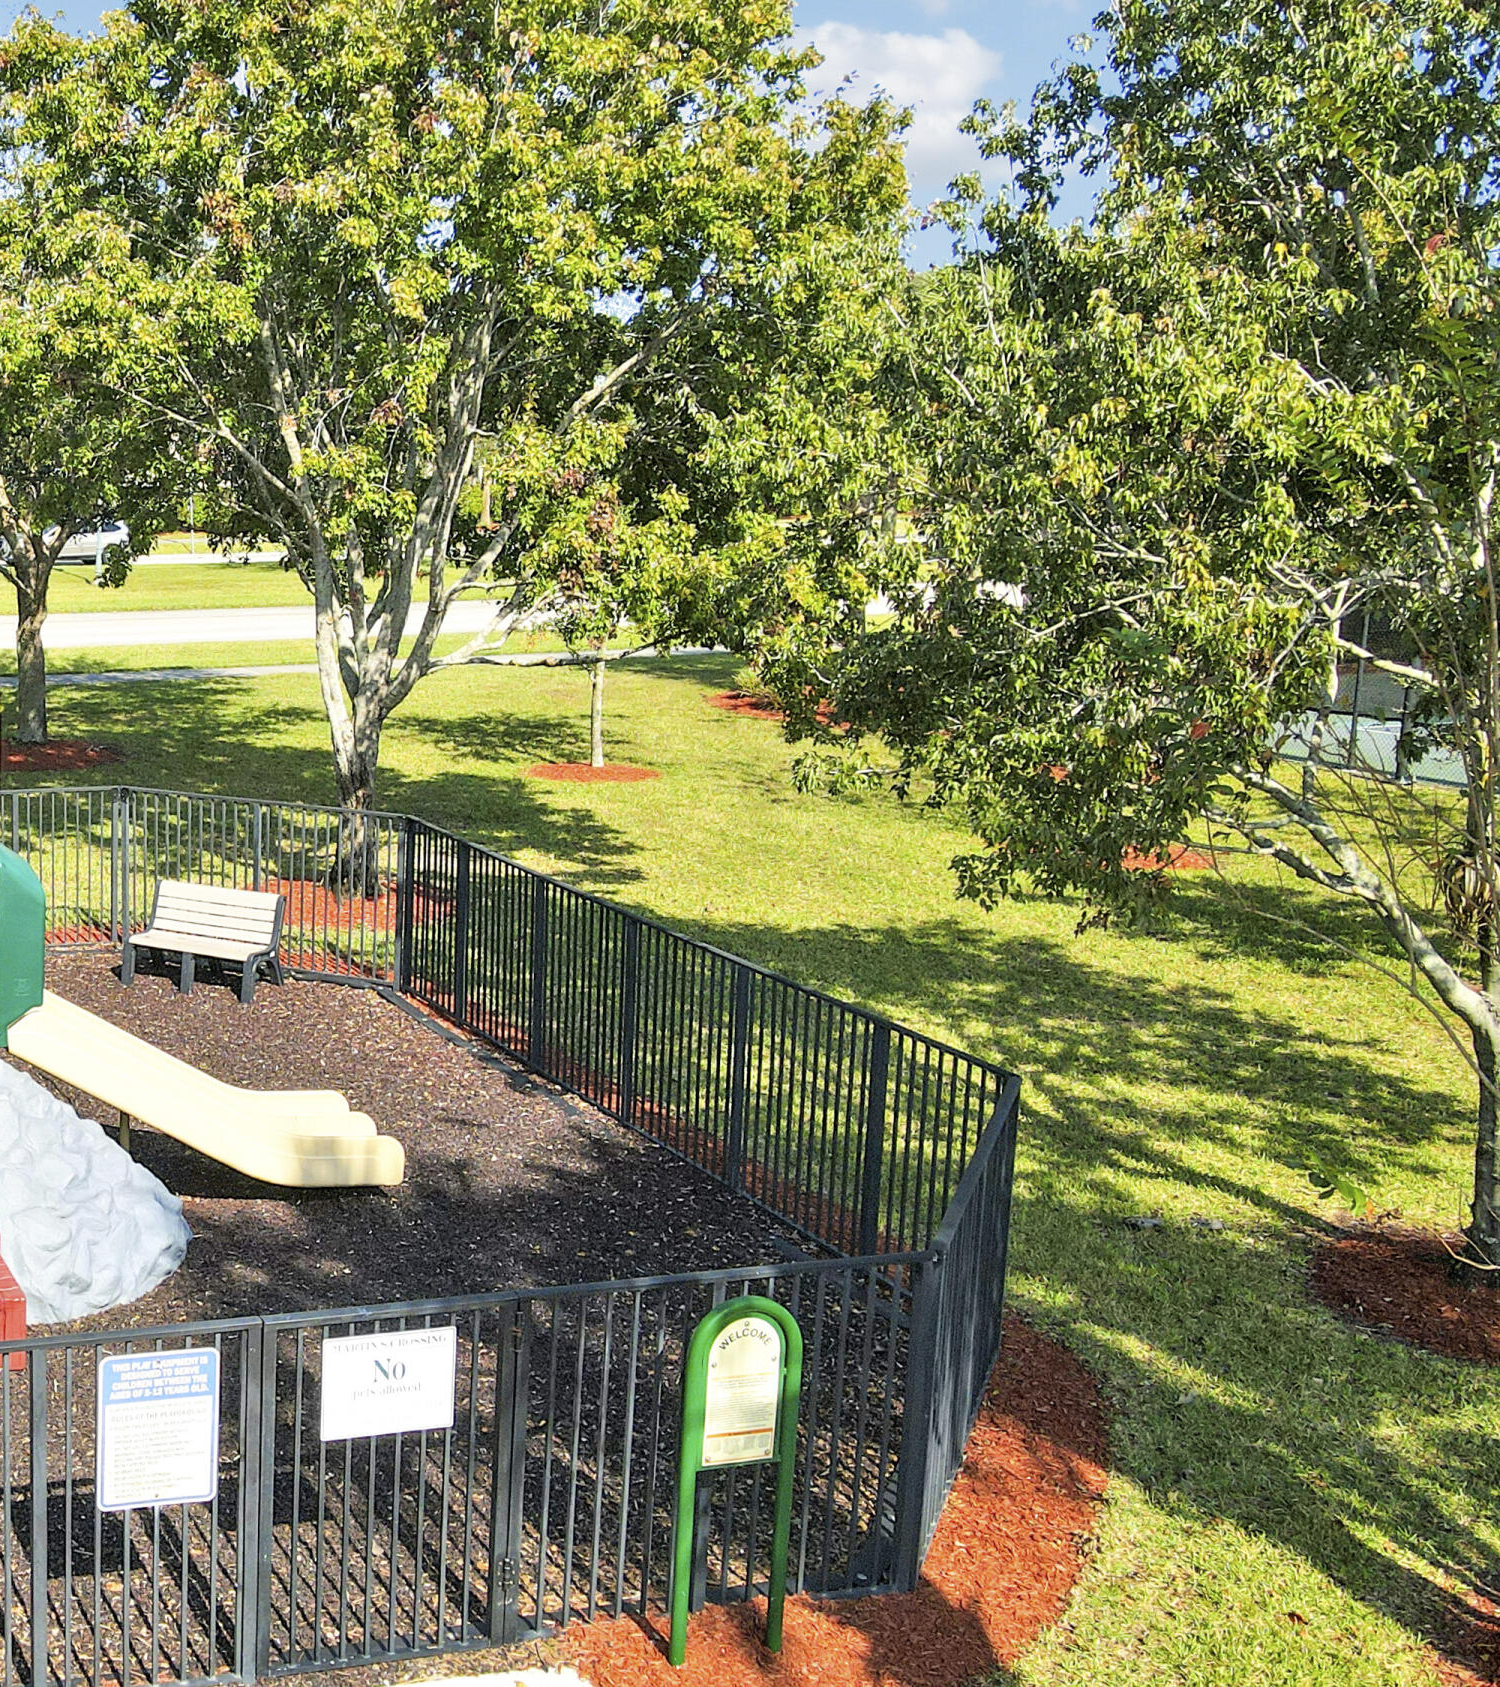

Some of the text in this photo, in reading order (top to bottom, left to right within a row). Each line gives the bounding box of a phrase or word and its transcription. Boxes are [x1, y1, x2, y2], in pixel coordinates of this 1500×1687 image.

[719, 1328, 772, 1350] WELCOME
[332, 1341, 387, 1353] MARTINS
[131, 1360, 151, 1371] PLAY
[162, 1367, 173, 1377] TO
[192, 1374, 208, 1383] THE
[132, 1388, 143, 1398] OF
